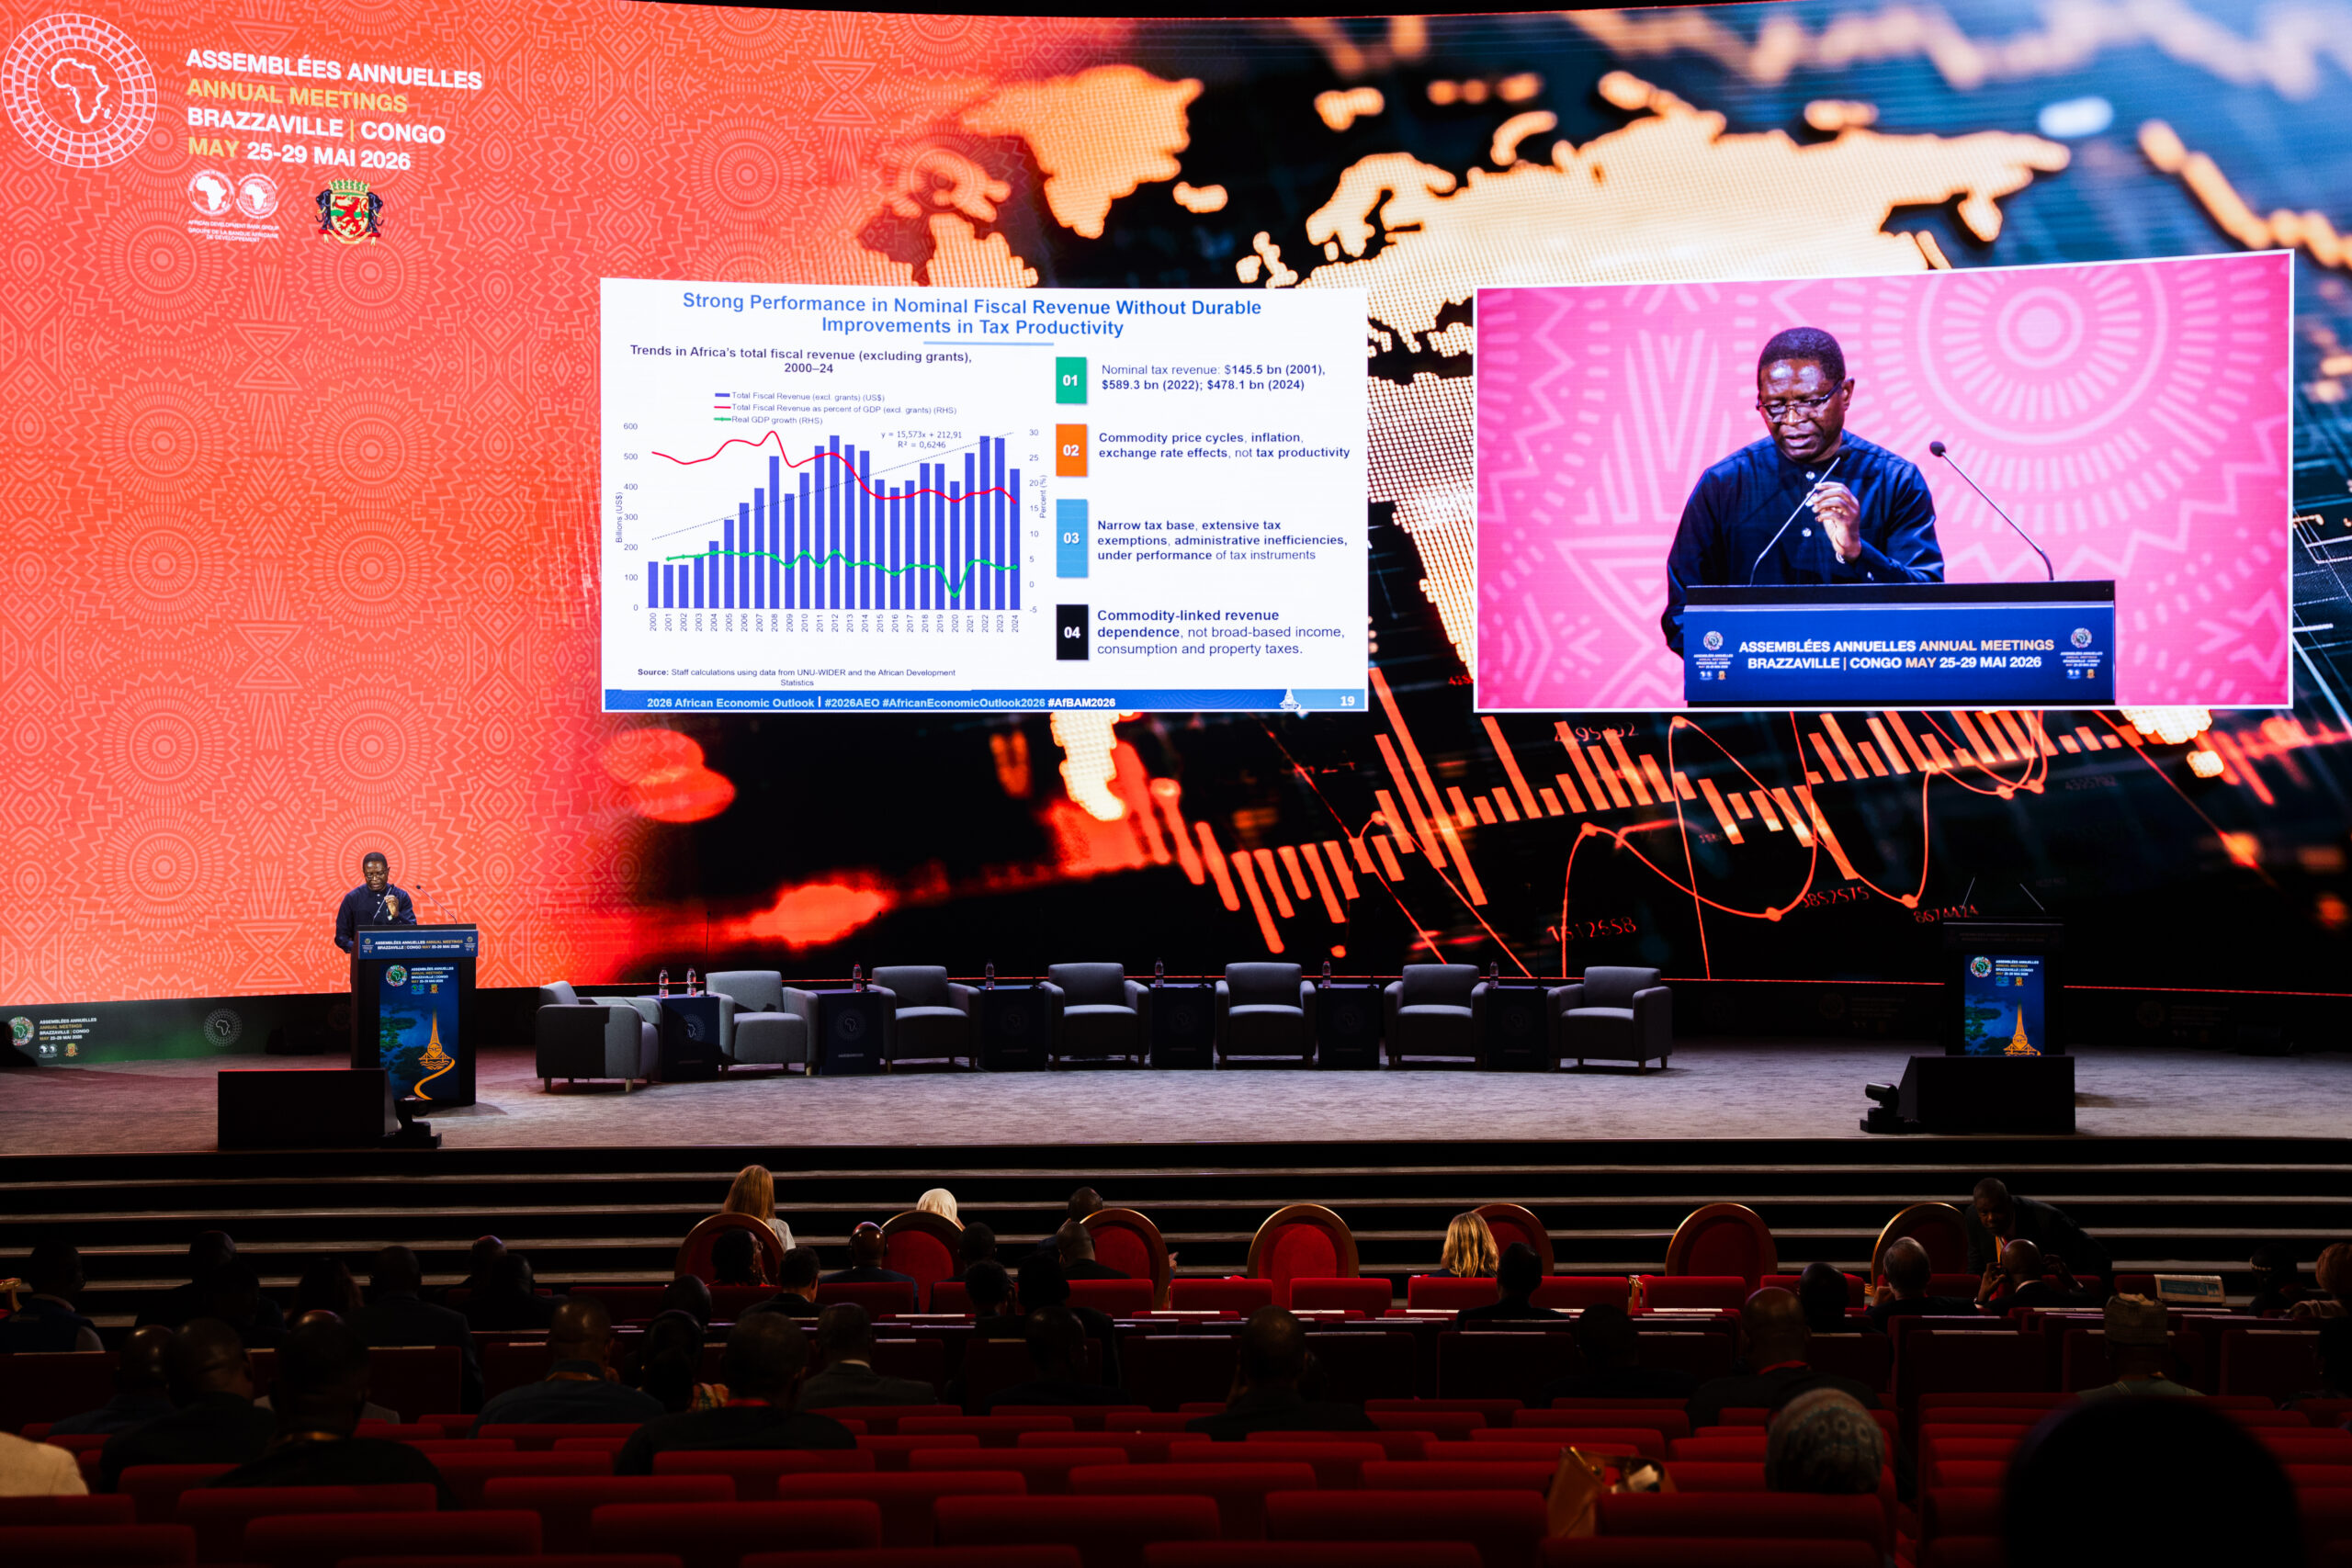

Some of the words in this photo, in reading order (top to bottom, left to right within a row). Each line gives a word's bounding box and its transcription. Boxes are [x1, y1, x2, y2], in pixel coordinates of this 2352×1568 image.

[186, 49, 341, 80] ASSEMBLÉES
[347, 62, 482, 90] ANNUELLES
[187, 78, 283, 104] ANNUAL
[289, 86, 408, 113] MEETINGS
[187, 107, 343, 138] BRAZZAVILLE
[361, 120, 446, 144] CONGO
[188, 137, 240, 158] MAY
[247, 141, 307, 164] 25-29
[314, 146, 356, 167] MAI
[361, 150, 411, 170] 2026
[684, 293, 743, 312] Strong
[751, 295, 865, 311] Performance
[873, 298, 887, 311] in
[895, 299, 967, 312] Nominal
[975, 299, 1026, 313] Fiscal
[1034, 300, 1110, 314] Revenue
[1116, 300, 1186, 314] Without
[1193, 300, 1261, 314] Durable
[822, 317, 951, 335] Improvements
[957, 319, 973, 333] in
[979, 320, 1010, 334] Tax
[1016, 320, 1124, 339] Productivity
[630, 344, 672, 355] Trends
[676, 346, 686, 356] in
[690, 346, 736, 357] Africa’s
[741, 348, 766, 358] total
[771, 348, 803, 359] fiscal
[807, 352, 855, 360] revenue
[859, 350, 922, 364] (excluding
[925, 352, 972, 364] grants),
[785, 363, 833, 373] 2000–24
[1102, 365, 1148, 375] Nominal
[1151, 366, 1168, 375] tax
[1171, 367, 1220, 375] revenue:
[1224, 364, 1263, 377] $145.5
[1267, 365, 1282, 375] bn
[1284, 364, 1326, 378] (2001),
[1062, 375, 1078, 386] 01
[1102, 379, 1140, 390] $589.3
[1144, 379, 1159, 389] bn
[1163, 379, 1203, 391] (2022);
[1207, 379, 1244, 390] $478.1
[1250, 379, 1264, 389] bn
[1268, 379, 1305, 391] (2024)
[776, 392, 810, 400] Revenue
[812, 393, 832, 401] (excl.
[834, 394, 861, 402] grants)
[863, 394, 885, 402] (US$)
[883, 406, 902, 414] (excl.
[905, 407, 932, 415] grants)
[933, 407, 956, 415] (RHS)
[771, 417, 797, 425] growth
[798, 417, 823, 425] (RHS)
[1099, 433, 1168, 445] Commodity
[1172, 433, 1202, 445] price
[1205, 433, 1247, 445] cycles,
[1251, 432, 1306, 445] inflation,
[1063, 445, 1080, 457] 02
[1099, 447, 1157, 460] exchange
[1160, 448, 1183, 457] rate
[1187, 447, 1230, 458] effects,
[1235, 448, 1252, 457] not
[1256, 448, 1274, 457] tax
[1278, 447, 1350, 459] productivity
[1098, 520, 1141, 530] Narrow
[1145, 521, 1162, 530] tax
[1167, 520, 1197, 531] base,
[1202, 520, 1260, 530] extensive
[1263, 521, 1281, 530] tax
[1063, 532, 1080, 545] 03
[1097, 536, 1170, 547] exemptions,
[1174, 536, 1261, 545] administrative
[1264, 535, 1347, 546] inefficiencies,
[1098, 550, 1132, 560] under
[1136, 550, 1212, 562] performance
[1216, 550, 1227, 559] of
[1230, 551, 1247, 559] tax
[1250, 550, 1316, 559] instruments
[1097, 610, 1220, 624] Commodity-linked
[1226, 612, 1279, 621] revenue
[1064, 626, 1080, 638] 04
[1097, 626, 1183, 640] dependence,
[1188, 627, 1207, 637] not
[1212, 626, 1291, 637] broad-based
[1295, 626, 1344, 638] income,
[1097, 643, 1177, 657] consumption
[1182, 643, 1204, 654] and
[1209, 644, 1261, 657] property
[1265, 644, 1303, 654] taxes.
[1738, 638, 1831, 653] ASSEMBLÉES
[1833, 640, 1917, 652] ANNUELLES
[1918, 640, 1977, 651] ANNUAL
[1981, 639, 2054, 651] MEETINGS
[1747, 658, 1839, 669] BRAZZAVILLE
[1849, 657, 1902, 669] CONGO
[1905, 657, 1937, 669] MAY
[1939, 657, 1977, 669] 25-29
[1980, 656, 2007, 668] MAI
[2009, 656, 2042, 668] 2026
[906, 669, 956, 677] Development
[647, 698, 673, 707] 2026
[674, 698, 713, 707] African
[716, 698, 770, 707] Economic
[773, 698, 815, 707] Outlook
[824, 698, 880, 707] #2026AEO
[882, 698, 1046, 707] #AfricanEconomicOutlook2026
[1047, 698, 1116, 707] #AfBAM2026
[1340, 695, 1355, 706] 19
